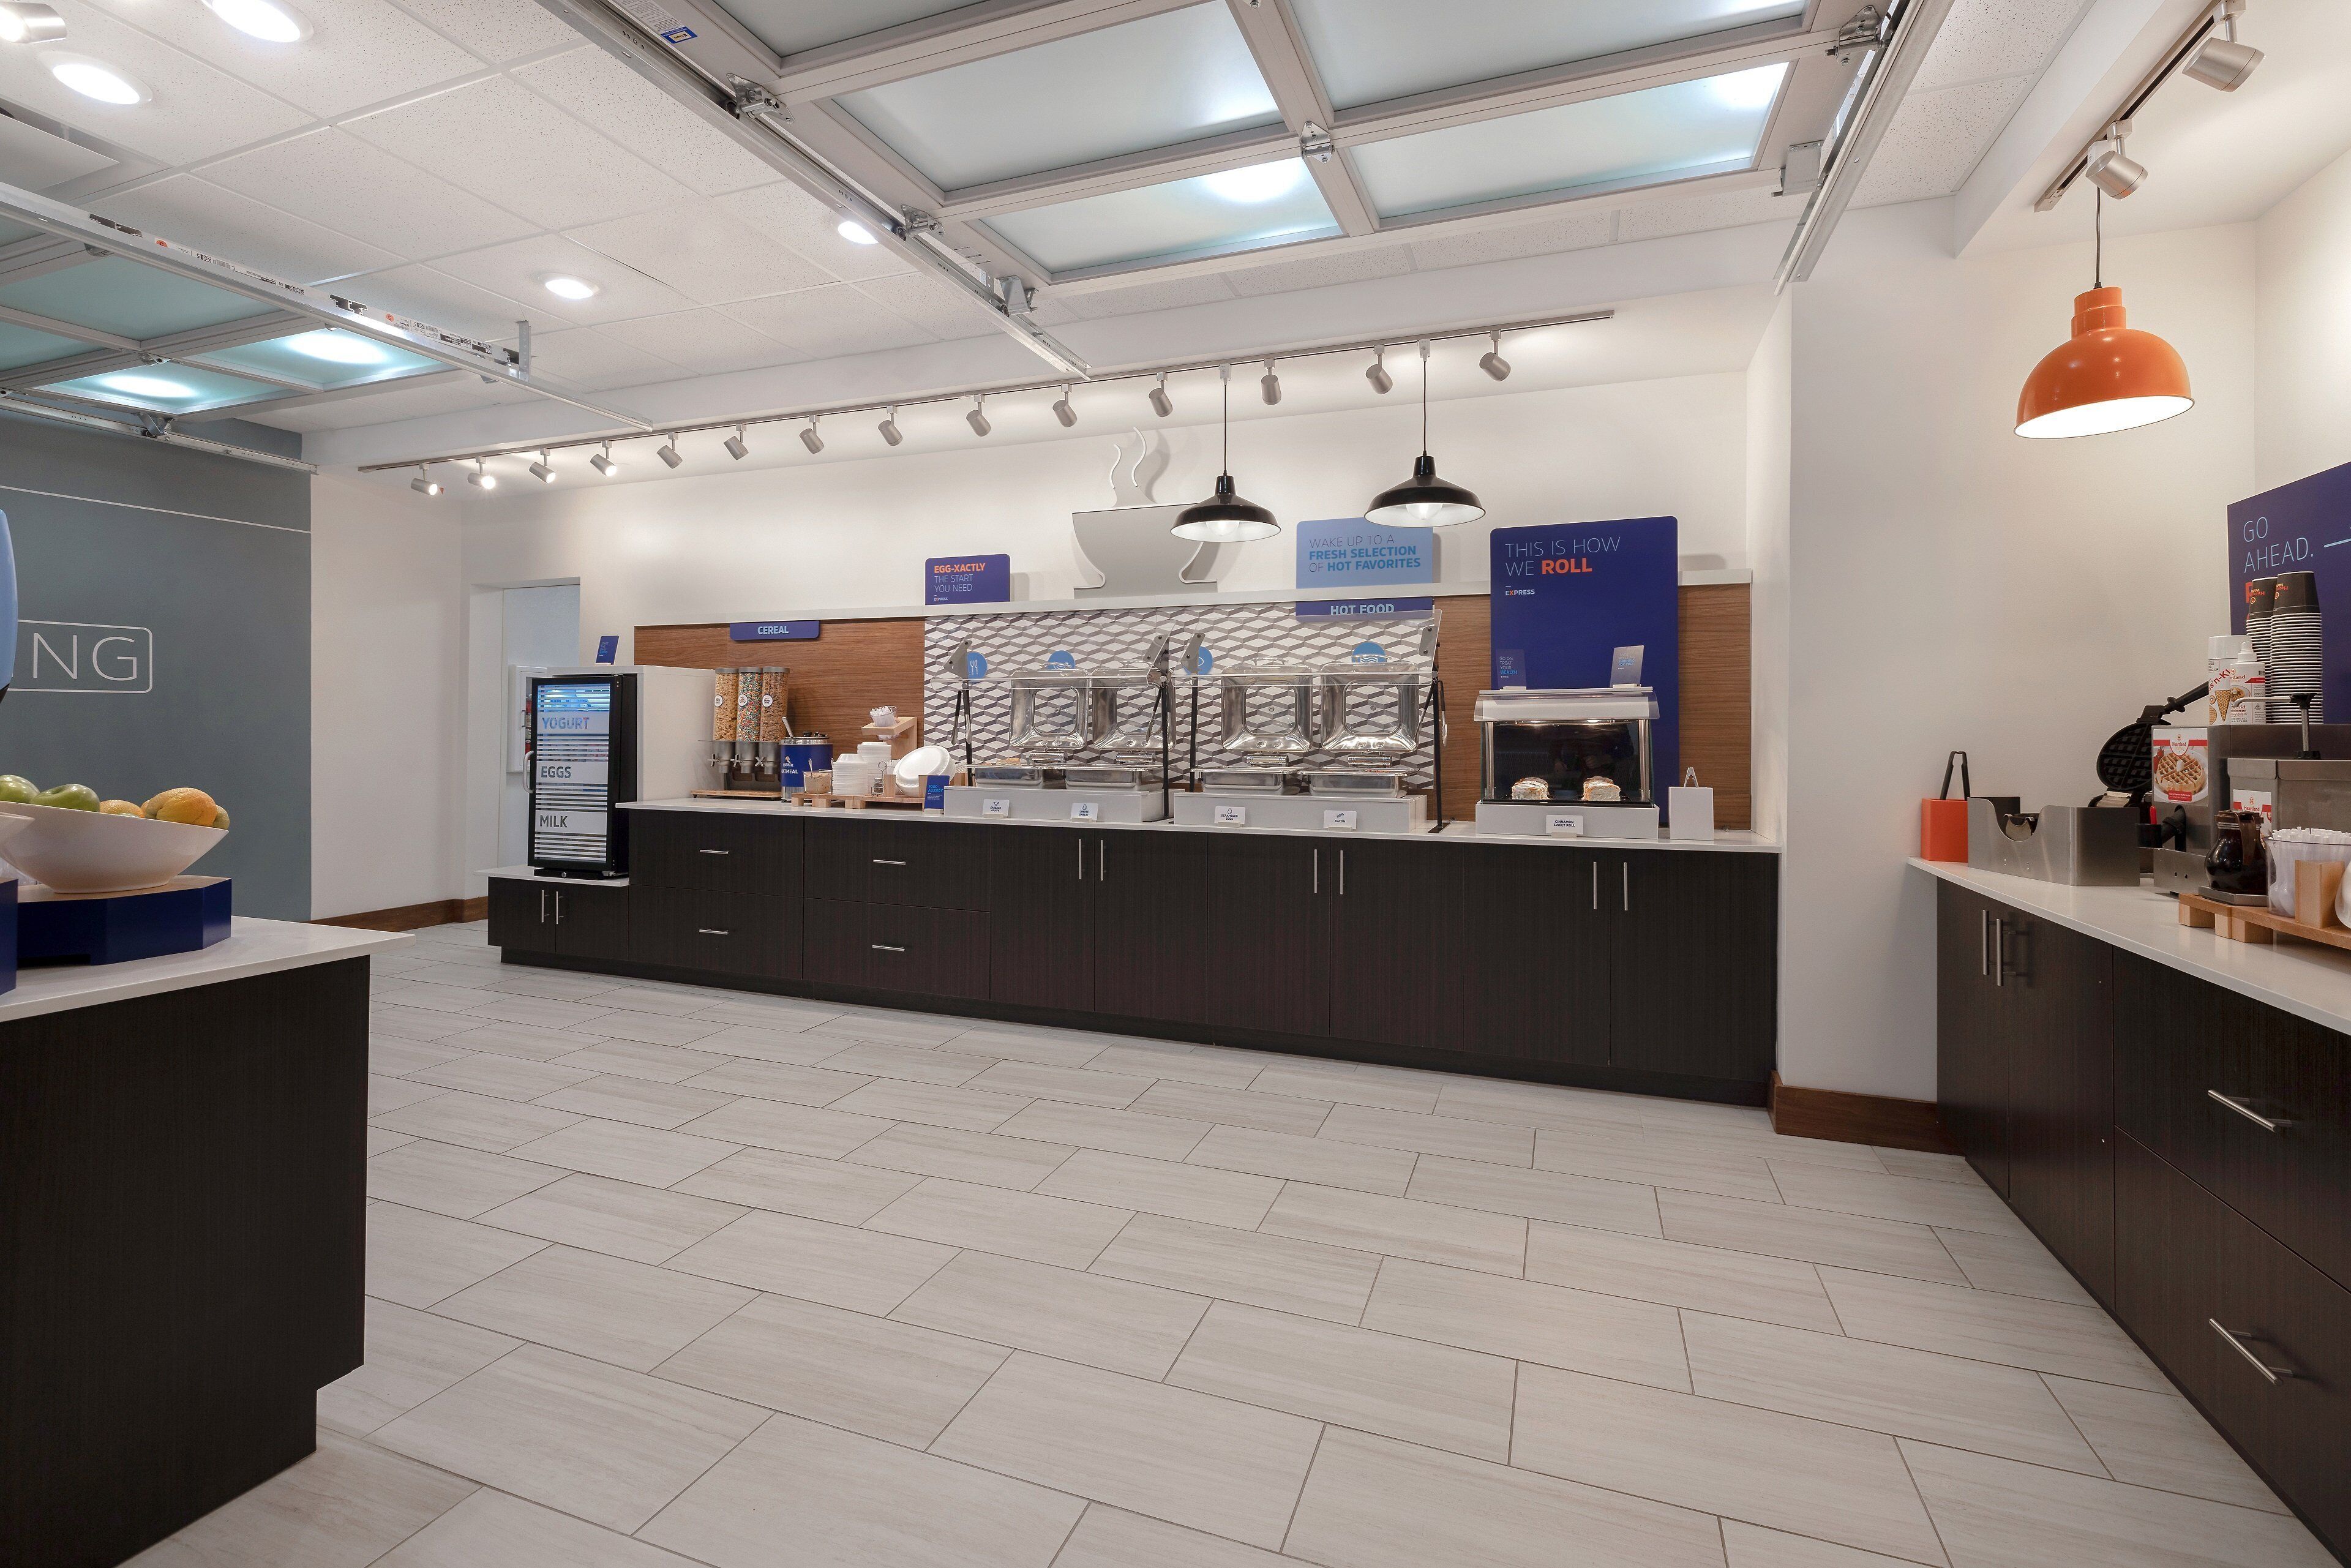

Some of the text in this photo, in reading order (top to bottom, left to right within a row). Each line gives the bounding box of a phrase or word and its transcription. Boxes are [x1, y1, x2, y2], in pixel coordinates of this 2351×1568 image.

[2243, 517, 2268, 542] GO
[1309, 534, 1395, 548] WAKE UP TO A
[1505, 536, 1621, 558] THIS IS HOW
[1309, 545, 1416, 560] FRESH SELECTION
[2244, 537, 2314, 574] AHEAD.
[934, 563, 986, 573] EGG-XACTLY
[1309, 557, 1421, 572] OF HOT FAVORITES
[1505, 558, 1593, 576] WE ROLL
[951, 574, 973, 582] START
[953, 583, 973, 592] NEED
[1330, 603, 1395, 615] HOT FOOD
[757, 625, 789, 635] CEREAL
[12, 632, 137, 681] NG
[542, 717, 590, 729] YOGURT
[541, 766, 572, 779] EGGS
[539, 814, 568, 828] MILK
